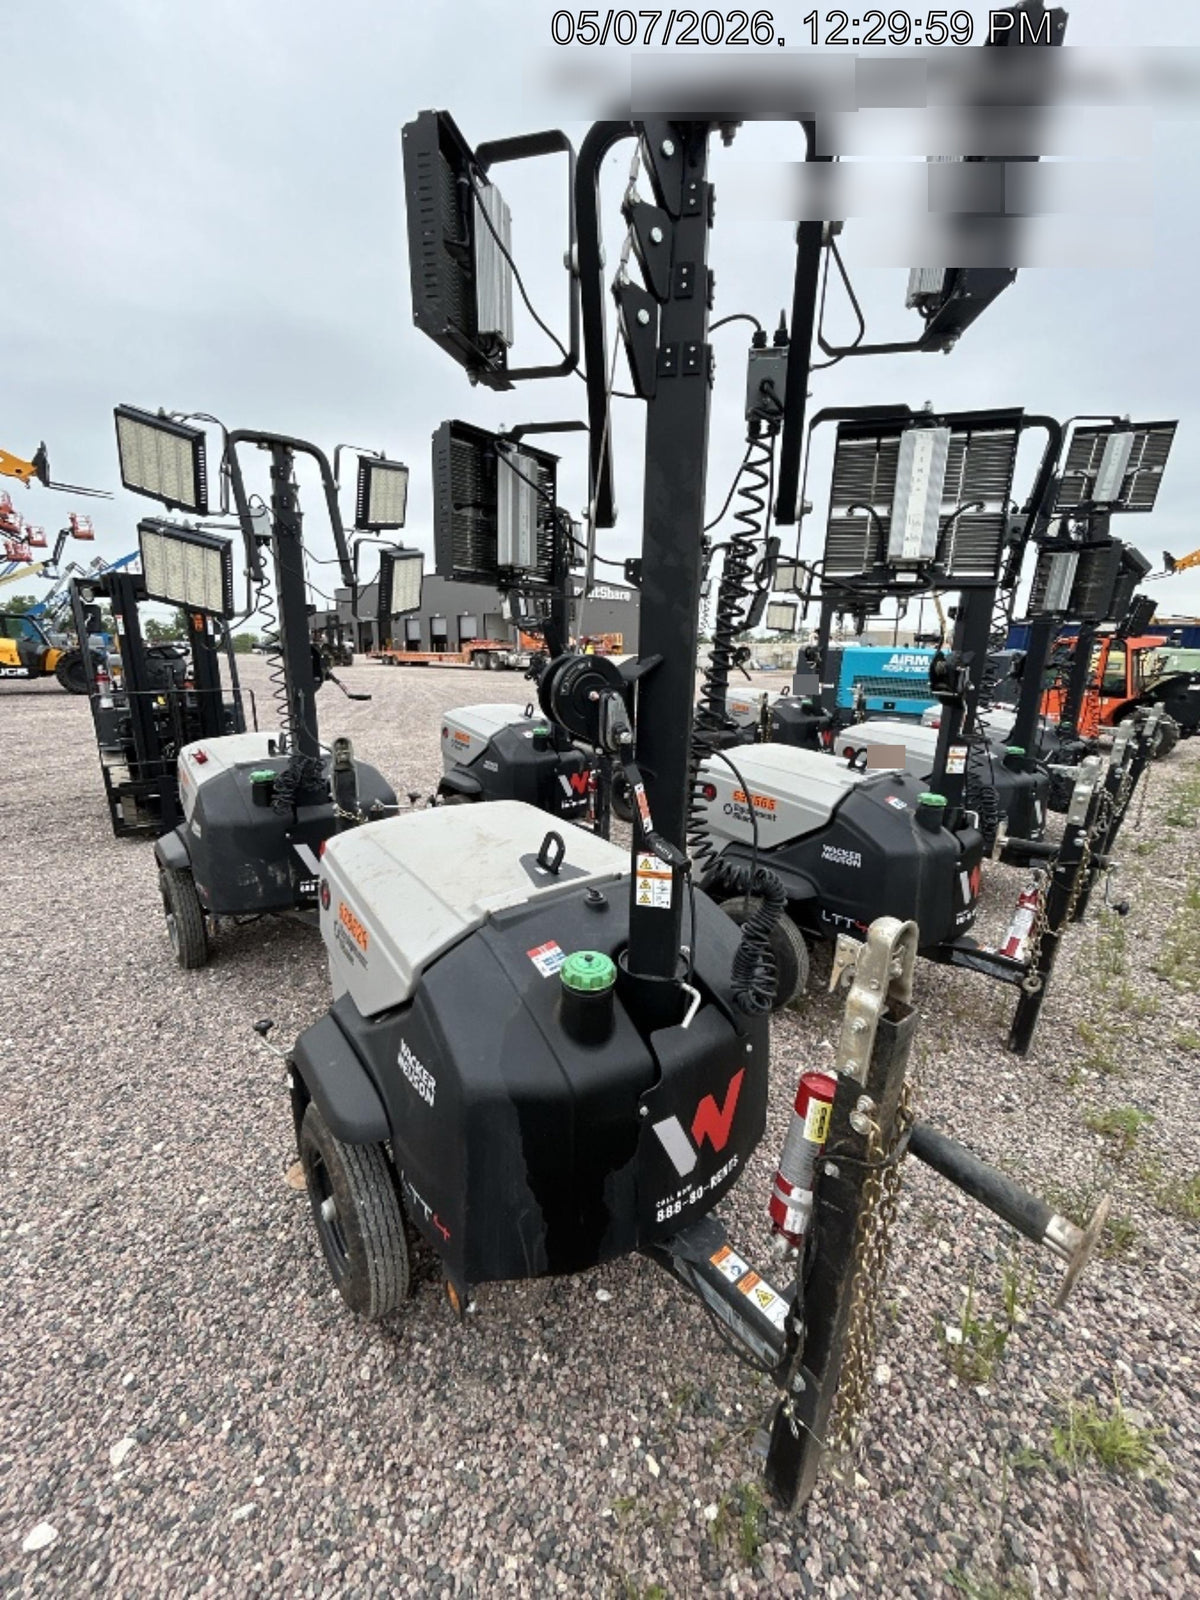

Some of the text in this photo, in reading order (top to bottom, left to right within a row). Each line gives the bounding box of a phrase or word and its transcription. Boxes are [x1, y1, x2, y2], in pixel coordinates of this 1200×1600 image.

[888, 654, 930, 666] AIRM
[397, 1051, 435, 1107] NEUSON
[400, 1038, 437, 1091] WACKER
